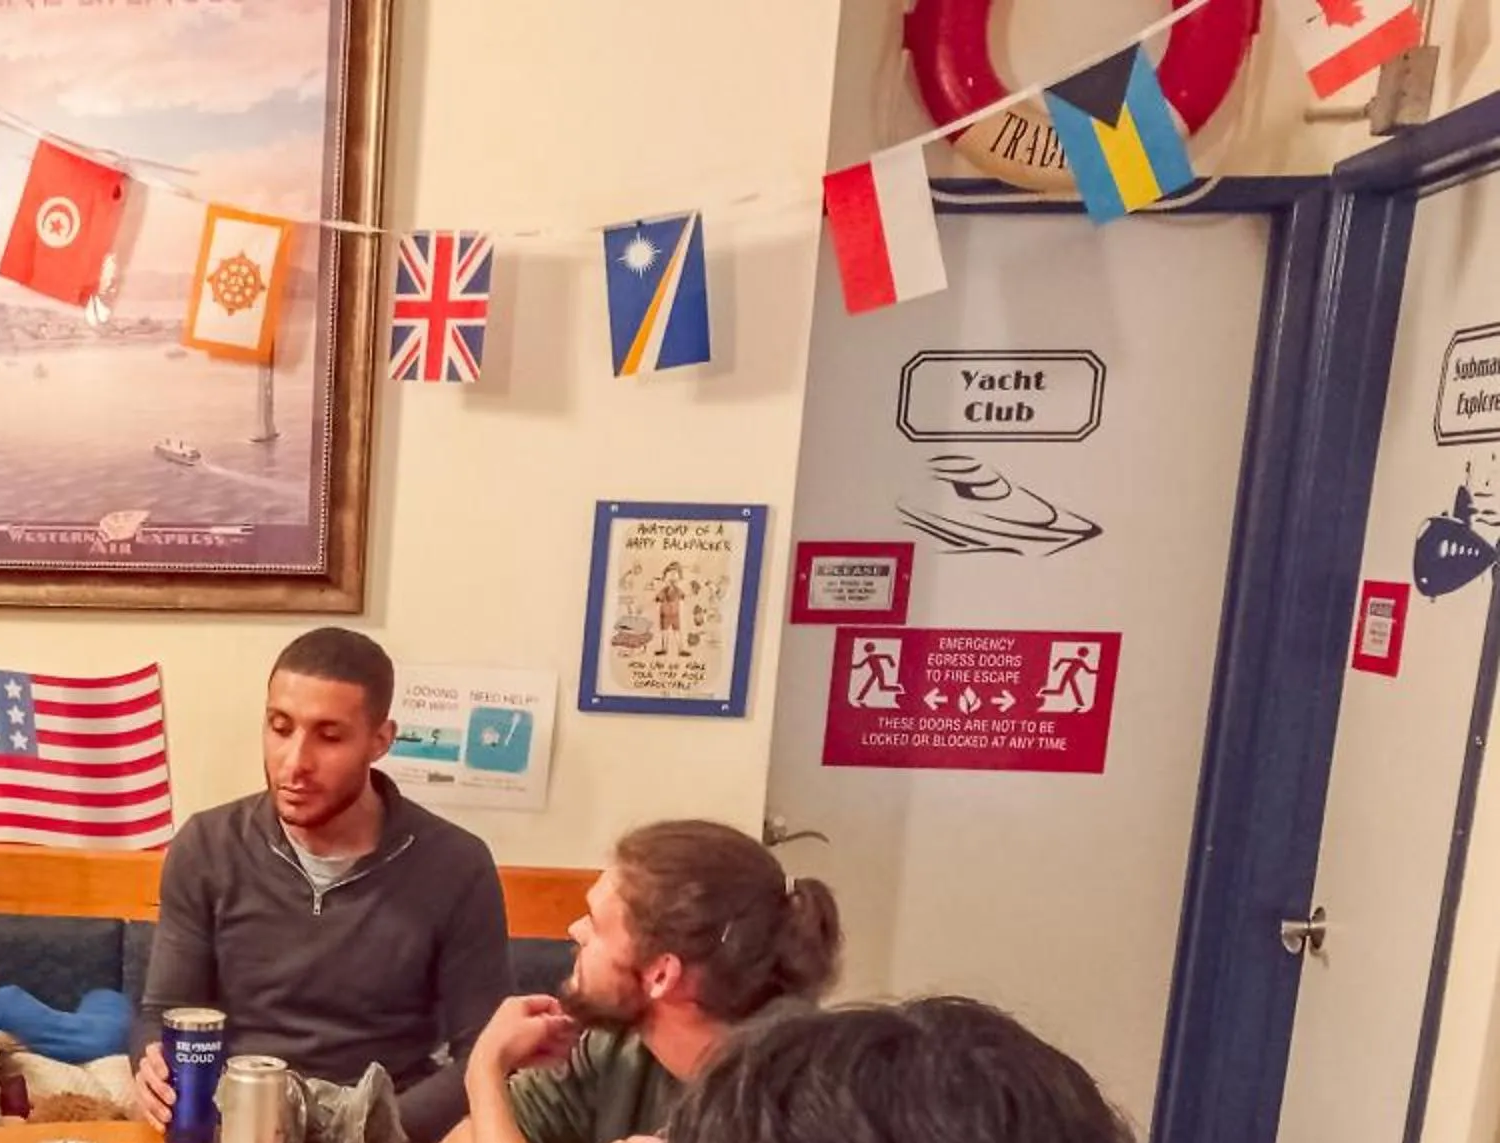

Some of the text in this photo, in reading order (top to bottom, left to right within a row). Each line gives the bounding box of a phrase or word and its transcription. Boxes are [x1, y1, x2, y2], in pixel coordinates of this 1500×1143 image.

[1453, 355, 1500, 381] Subma
[960, 370, 1046, 392] Yacht
[964, 401, 1035, 423] Club
[939, 637, 1016, 651] EMERGENCY
[927, 652, 1023, 668] EGRESS DOORS
[926, 668, 1021, 685] TO FIRE ESCAPE
[878, 716, 1056, 734] THESE DOORS ARE NOT TO BE
[861, 732, 1068, 751] LOCKED OR BLOCKED AT ANY TIME
[175, 1051, 215, 1063] CLOUD
